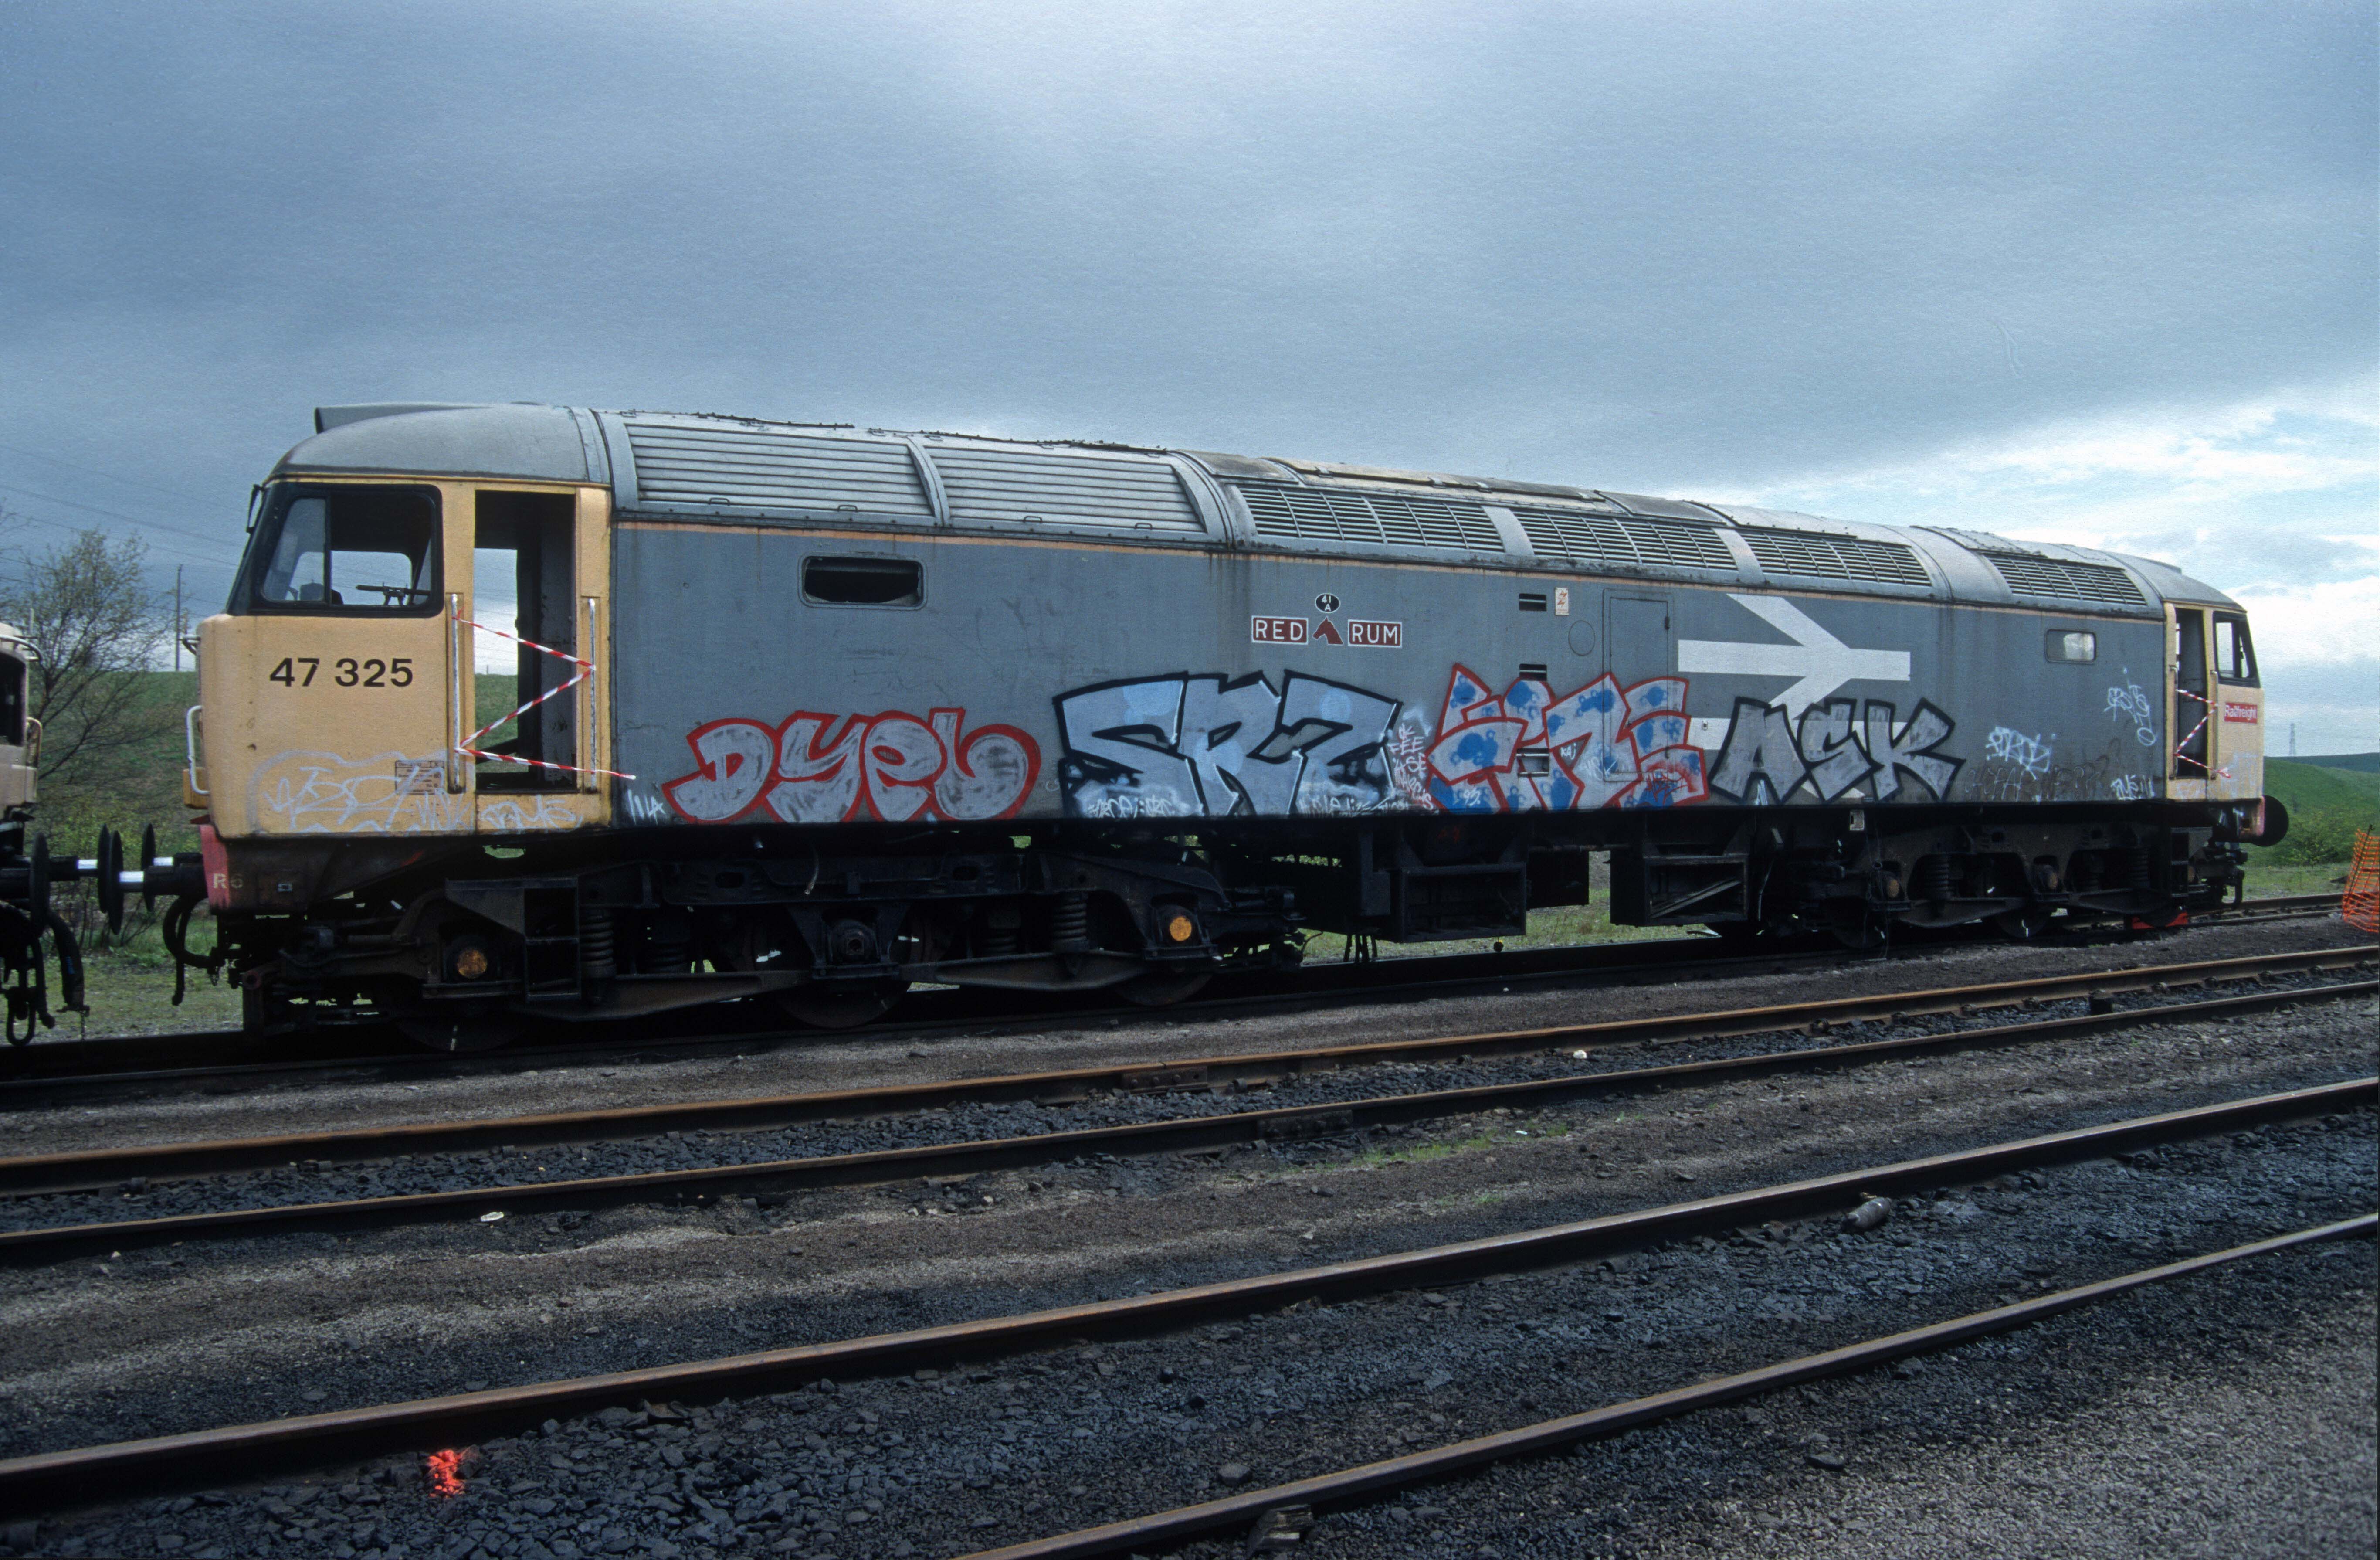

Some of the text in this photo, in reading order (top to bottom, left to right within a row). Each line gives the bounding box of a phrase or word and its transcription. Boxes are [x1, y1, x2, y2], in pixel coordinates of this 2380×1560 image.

[1321, 595, 1332, 603] 41
[1255, 619, 1397, 644] RED RUM
[269, 657, 413, 687] 47 325
[1707, 697, 1966, 804] ASK
